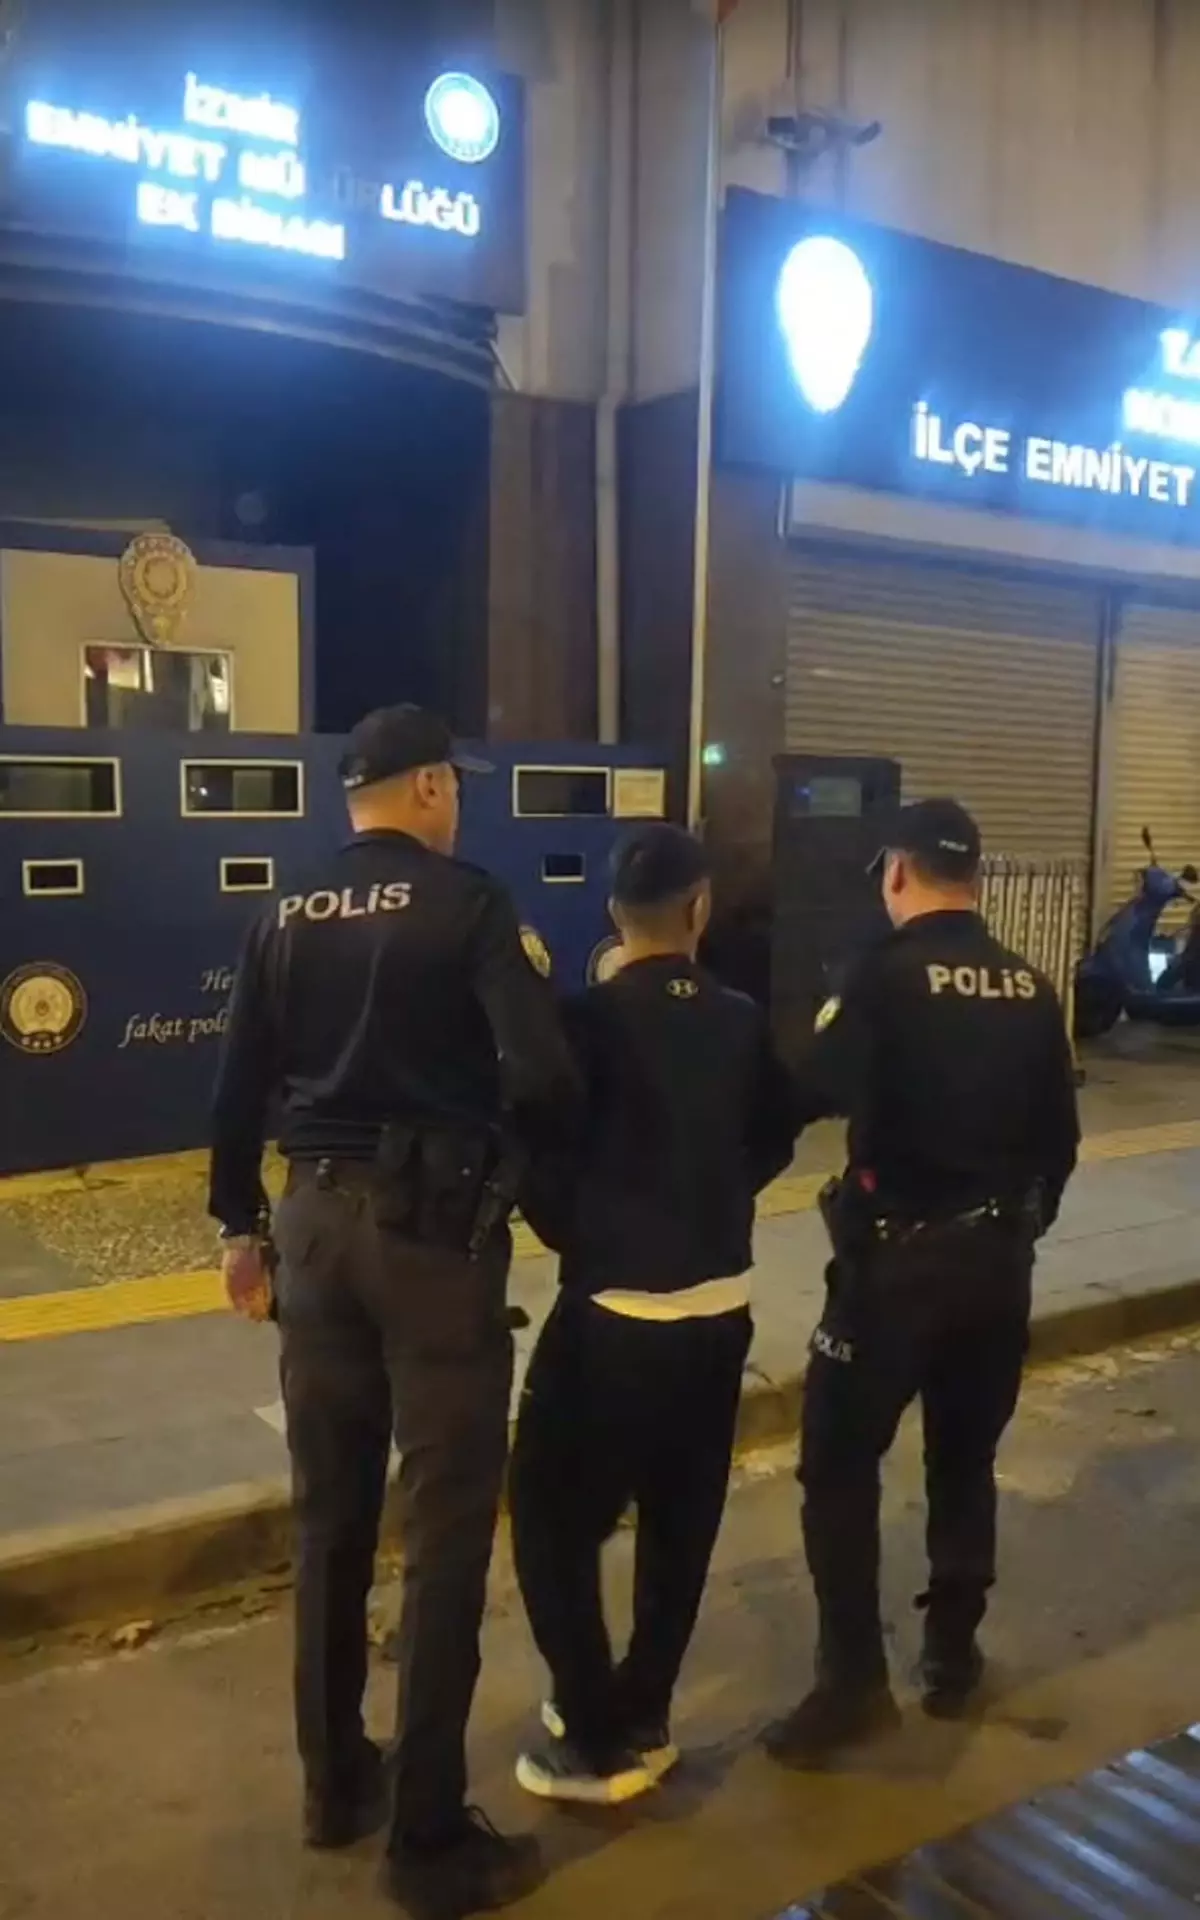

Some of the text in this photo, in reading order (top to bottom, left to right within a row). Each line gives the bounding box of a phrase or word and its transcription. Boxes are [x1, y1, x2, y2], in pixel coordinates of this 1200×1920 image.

[913, 400, 1195, 507] İLÇE EMNİYET
[117, 1011, 185, 1049] fakat
